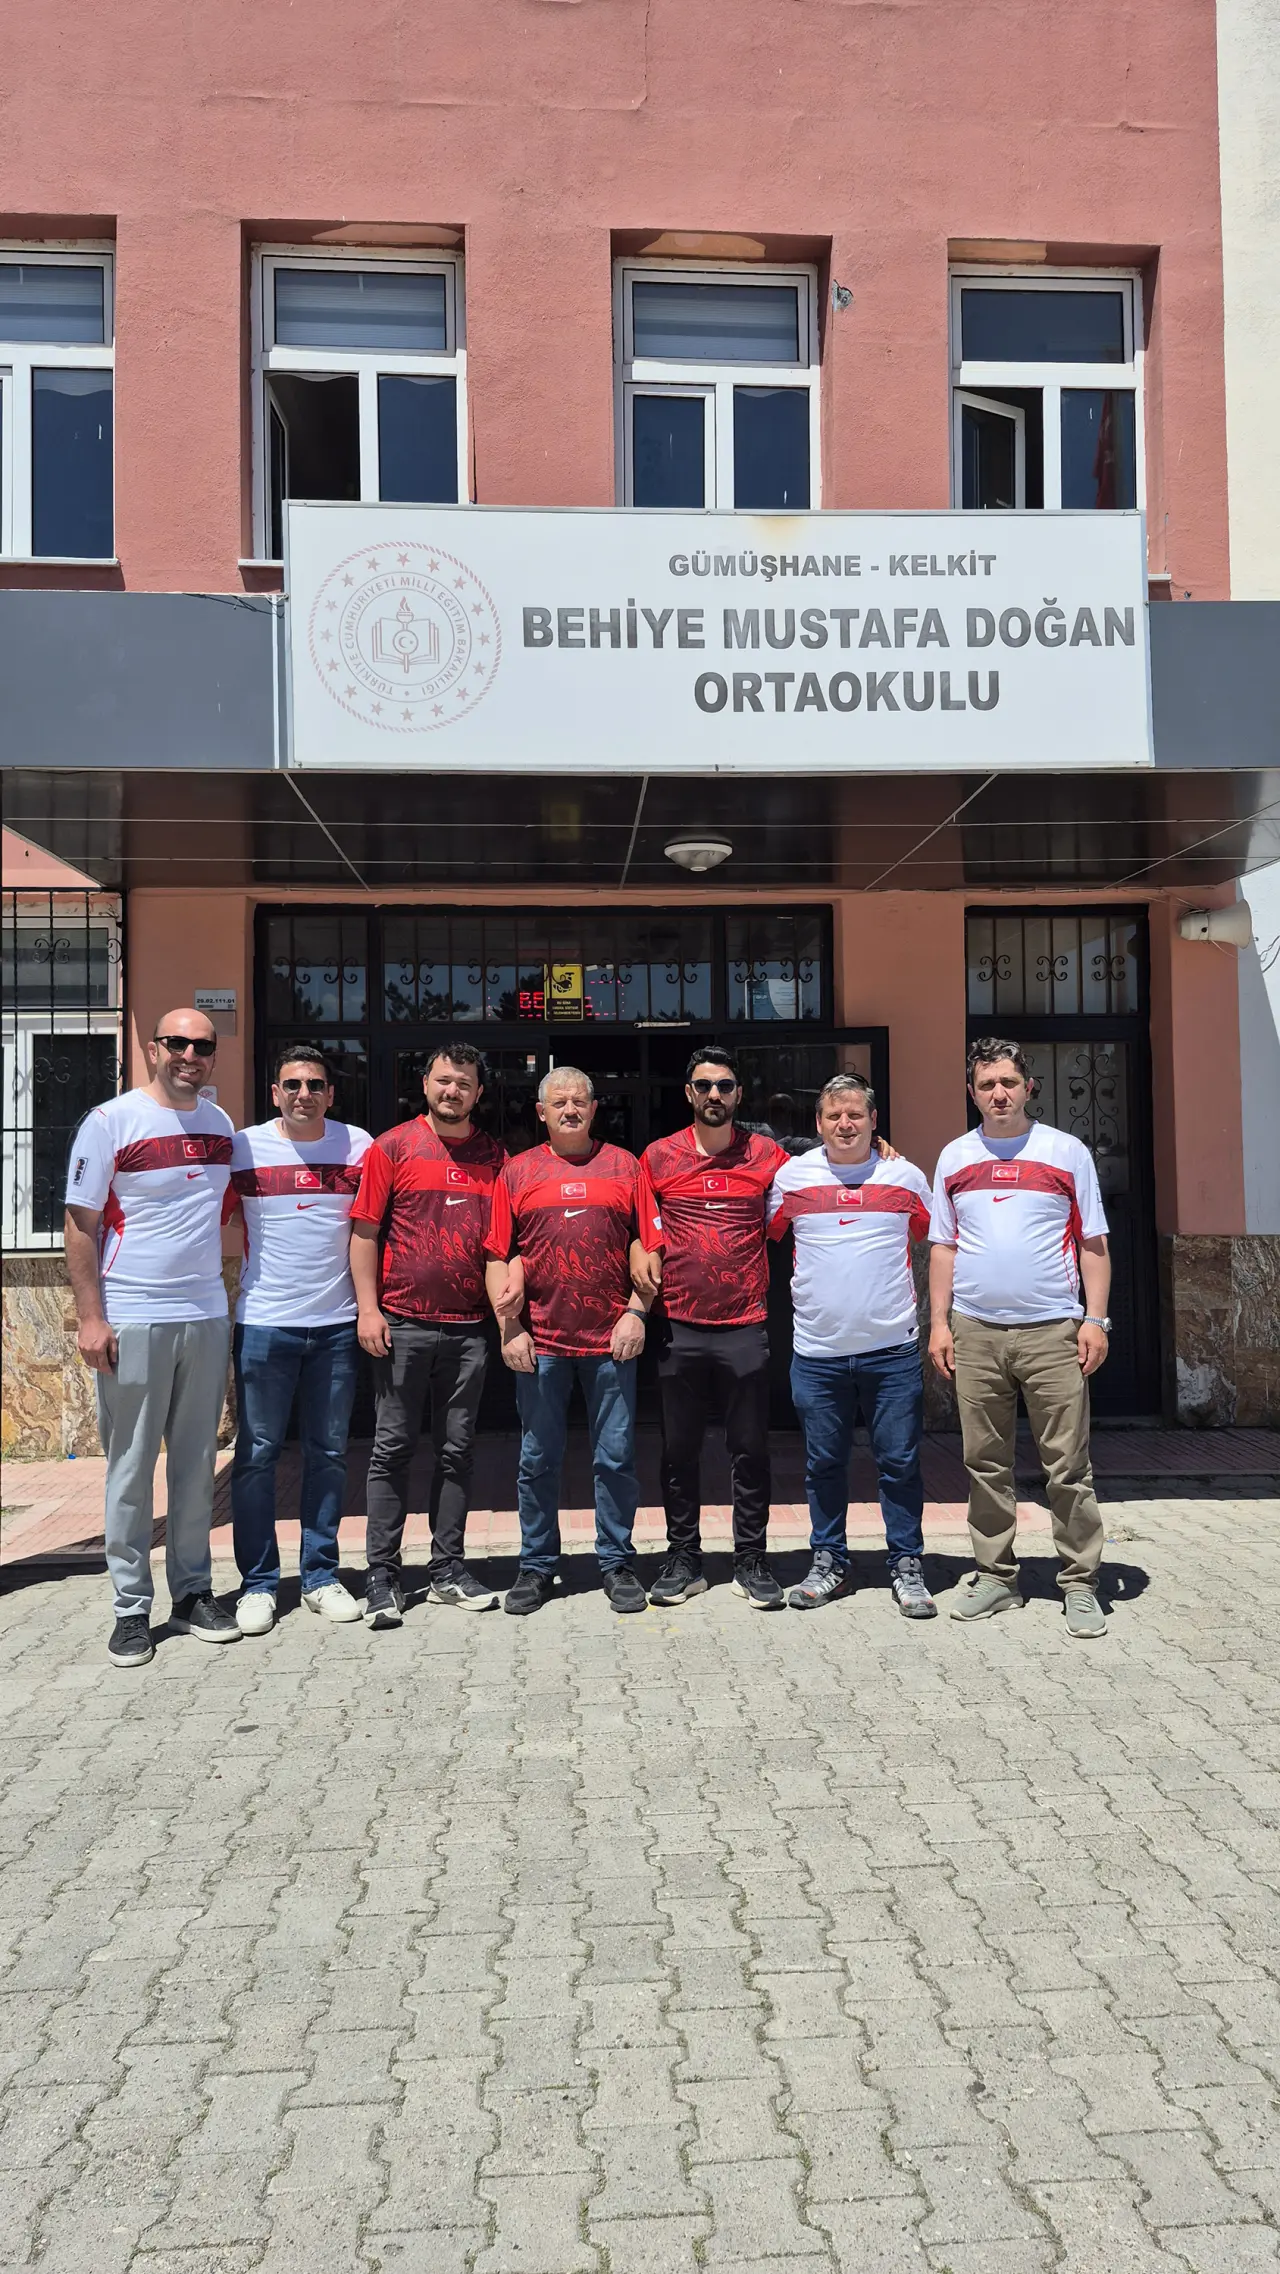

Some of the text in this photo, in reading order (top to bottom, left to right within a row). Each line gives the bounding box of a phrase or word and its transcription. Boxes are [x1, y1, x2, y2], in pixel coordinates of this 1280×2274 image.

[668, 550, 862, 584] GÜMÜŞHANE
[889, 549, 998, 577] KELKİT
[344, 575, 397, 650] CUMHURİYETİ
[437, 591, 466, 635] EĞİTİM
[522, 596, 1136, 650] BEHİYE MUSTAFA DOĞAN
[349, 653, 394, 696] TÜRKİYE
[421, 638, 467, 696] BAKANLIĞI
[694, 670, 1001, 714] ORTAOKULU
